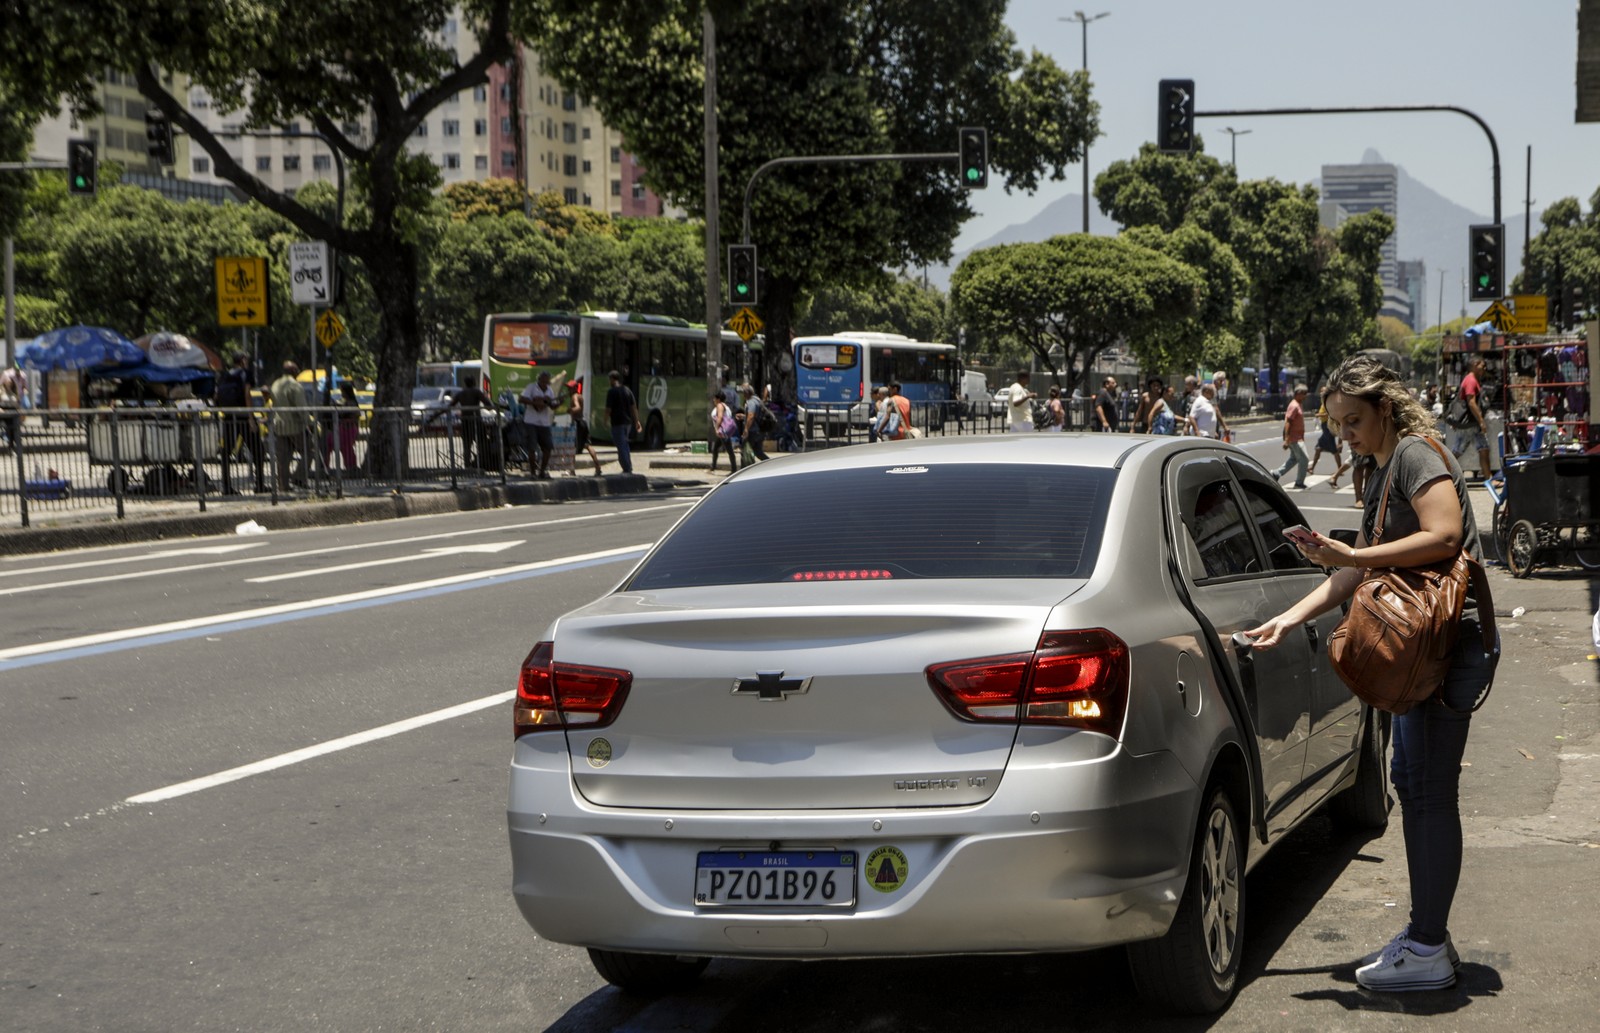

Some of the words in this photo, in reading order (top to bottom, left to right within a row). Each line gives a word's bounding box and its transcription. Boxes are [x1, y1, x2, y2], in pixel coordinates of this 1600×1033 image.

[552, 323, 571, 337] 220
[840, 345, 854, 354] 422
[697, 893, 707, 902] BR
